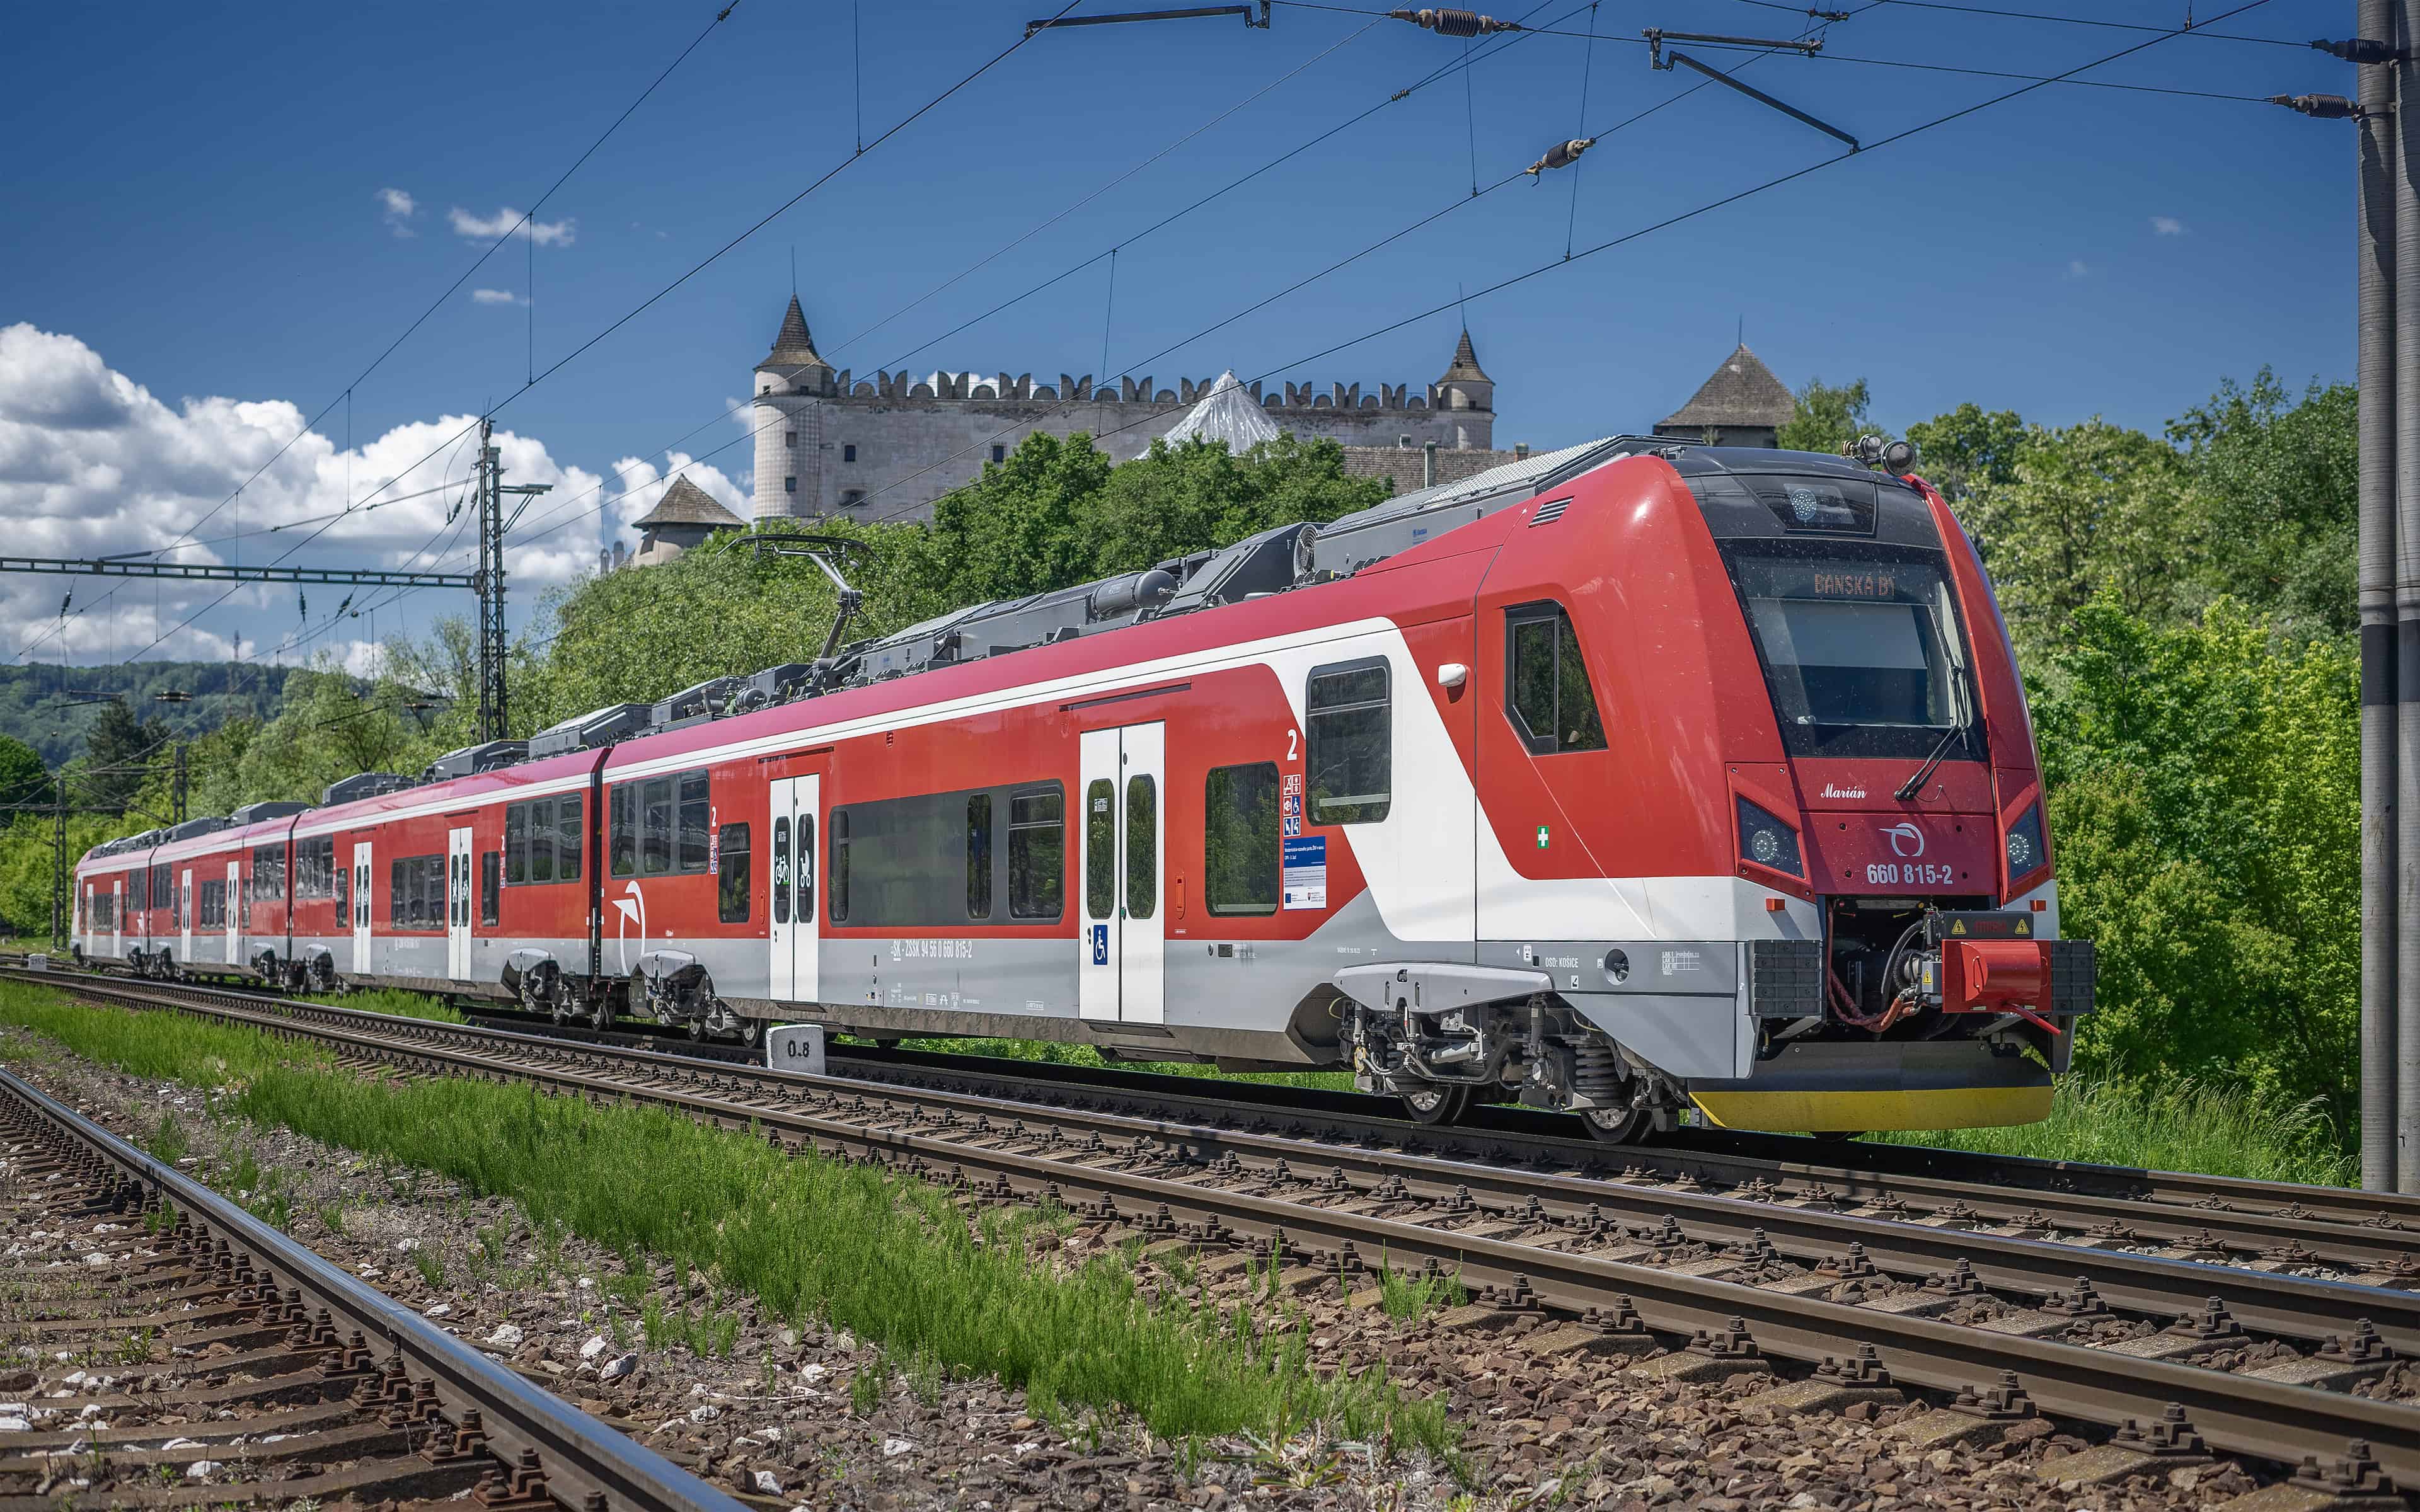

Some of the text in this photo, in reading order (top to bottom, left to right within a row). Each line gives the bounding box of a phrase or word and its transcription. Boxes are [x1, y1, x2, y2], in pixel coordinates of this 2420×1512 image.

[1287, 729, 1298, 760] 2
[1820, 782, 1867, 798] Marián
[712, 806, 717, 827] 2
[1867, 864, 1953, 885] 660 815-2
[921, 941, 928, 958] 94
[930, 941, 937, 958] 56
[943, 941, 954, 958] 660
[955, 941, 972, 958] 815-2
[1545, 955, 1579, 968] OSD: KOŠICE
[788, 1040, 810, 1058] 0.8
